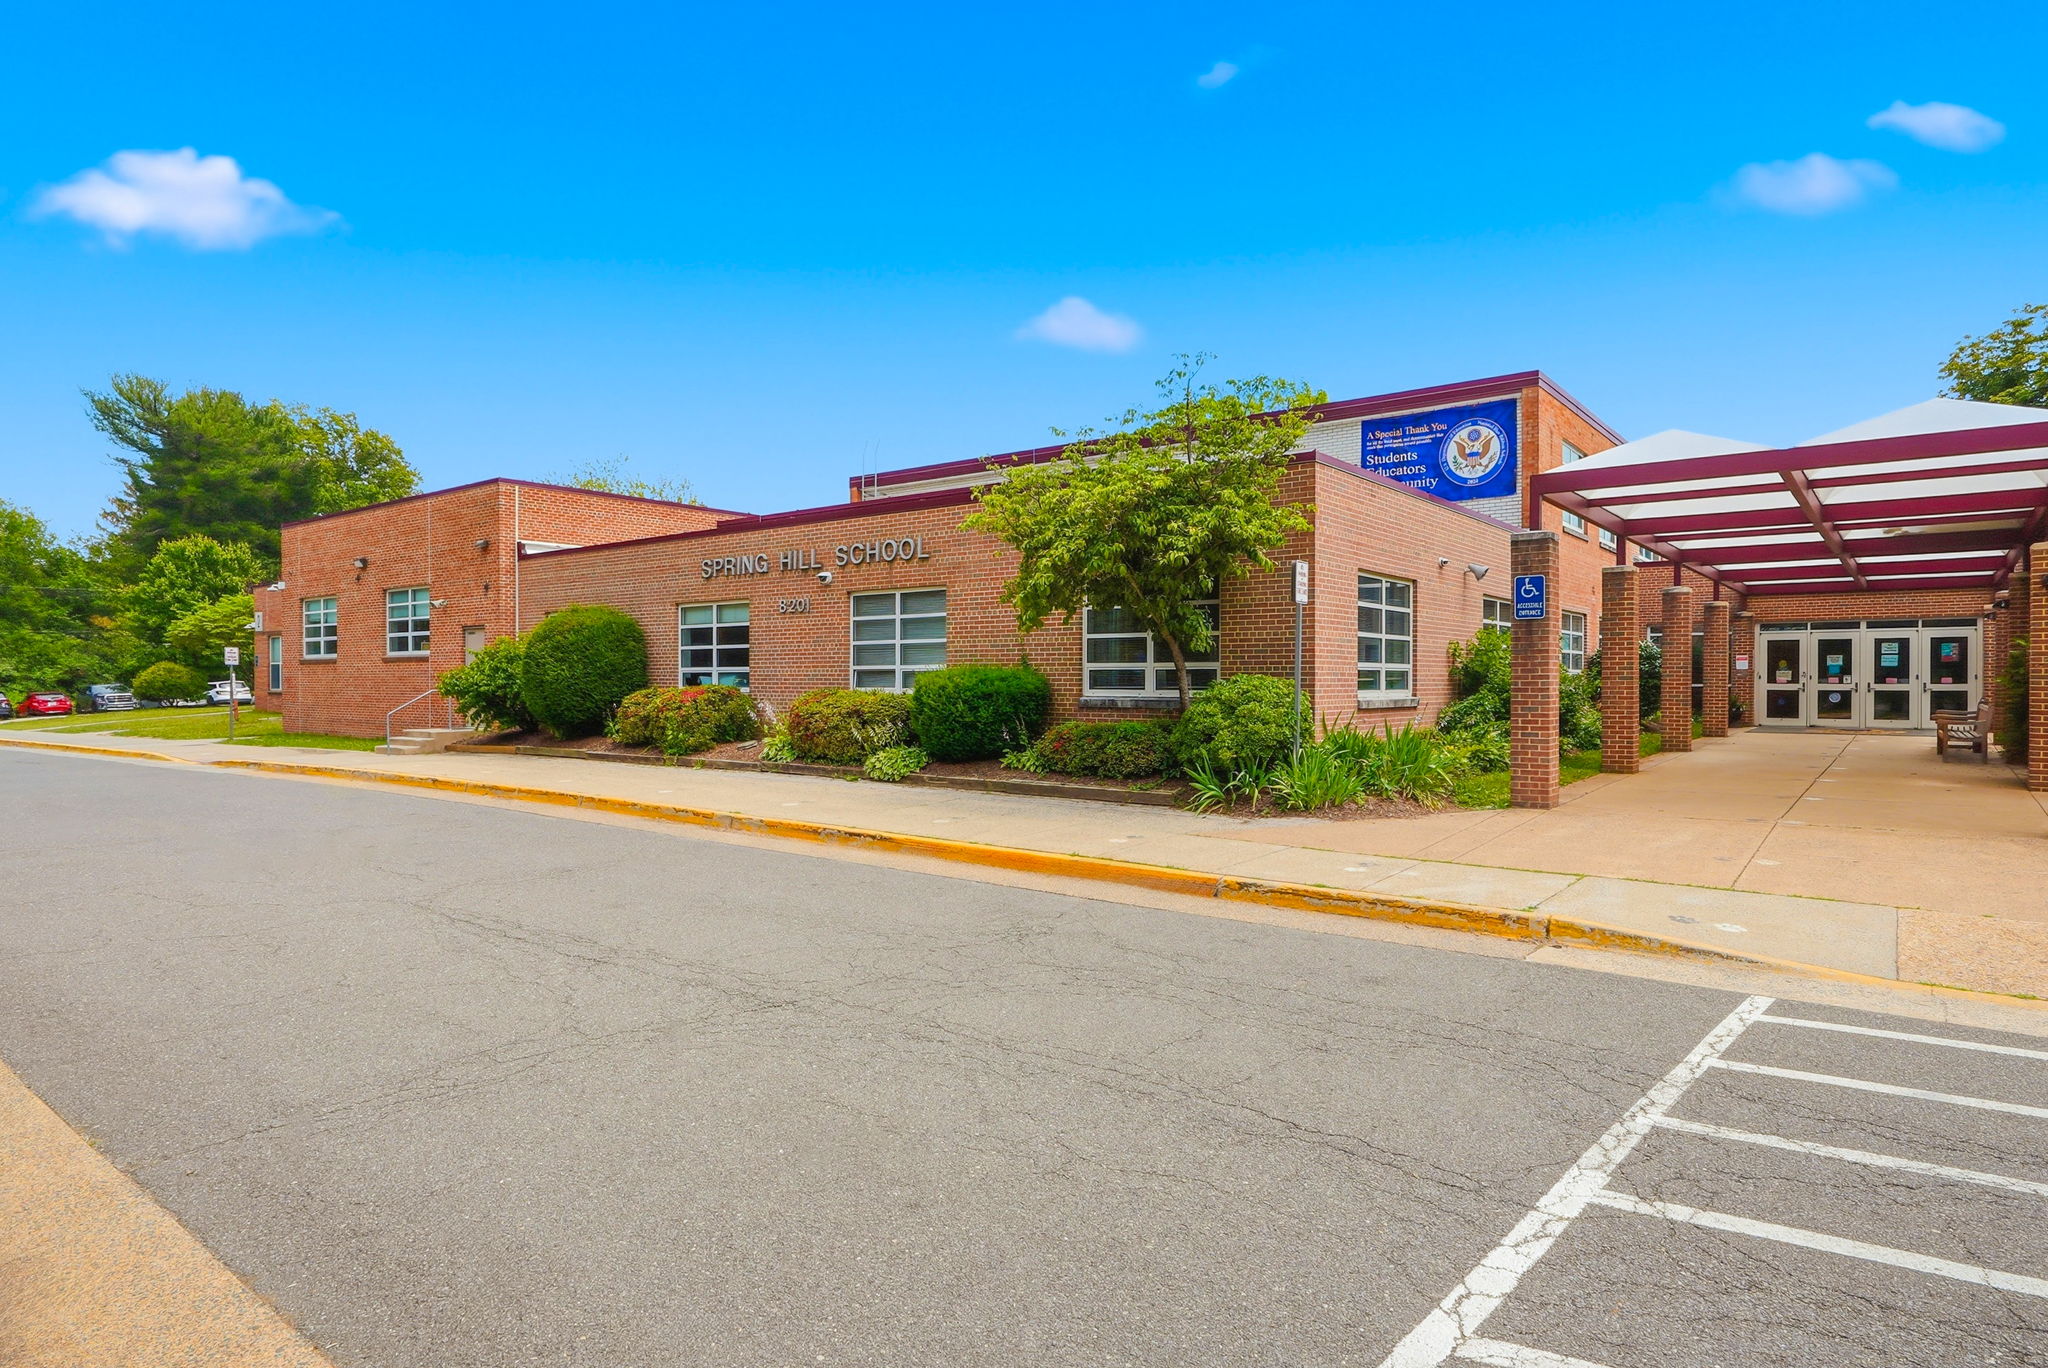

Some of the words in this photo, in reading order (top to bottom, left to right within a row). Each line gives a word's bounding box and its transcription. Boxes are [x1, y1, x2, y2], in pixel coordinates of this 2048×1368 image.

[1375, 428, 1402, 439] Special
[1405, 425, 1429, 434] Thank
[1431, 422, 1447, 431] You
[1366, 452, 1418, 465] Students
[1366, 464, 1426, 477] ducators
[701, 553, 769, 579] SPRING
[779, 549, 822, 571] HILL
[835, 536, 930, 566] SCHOOL
[779, 597, 811, 614] 8201
